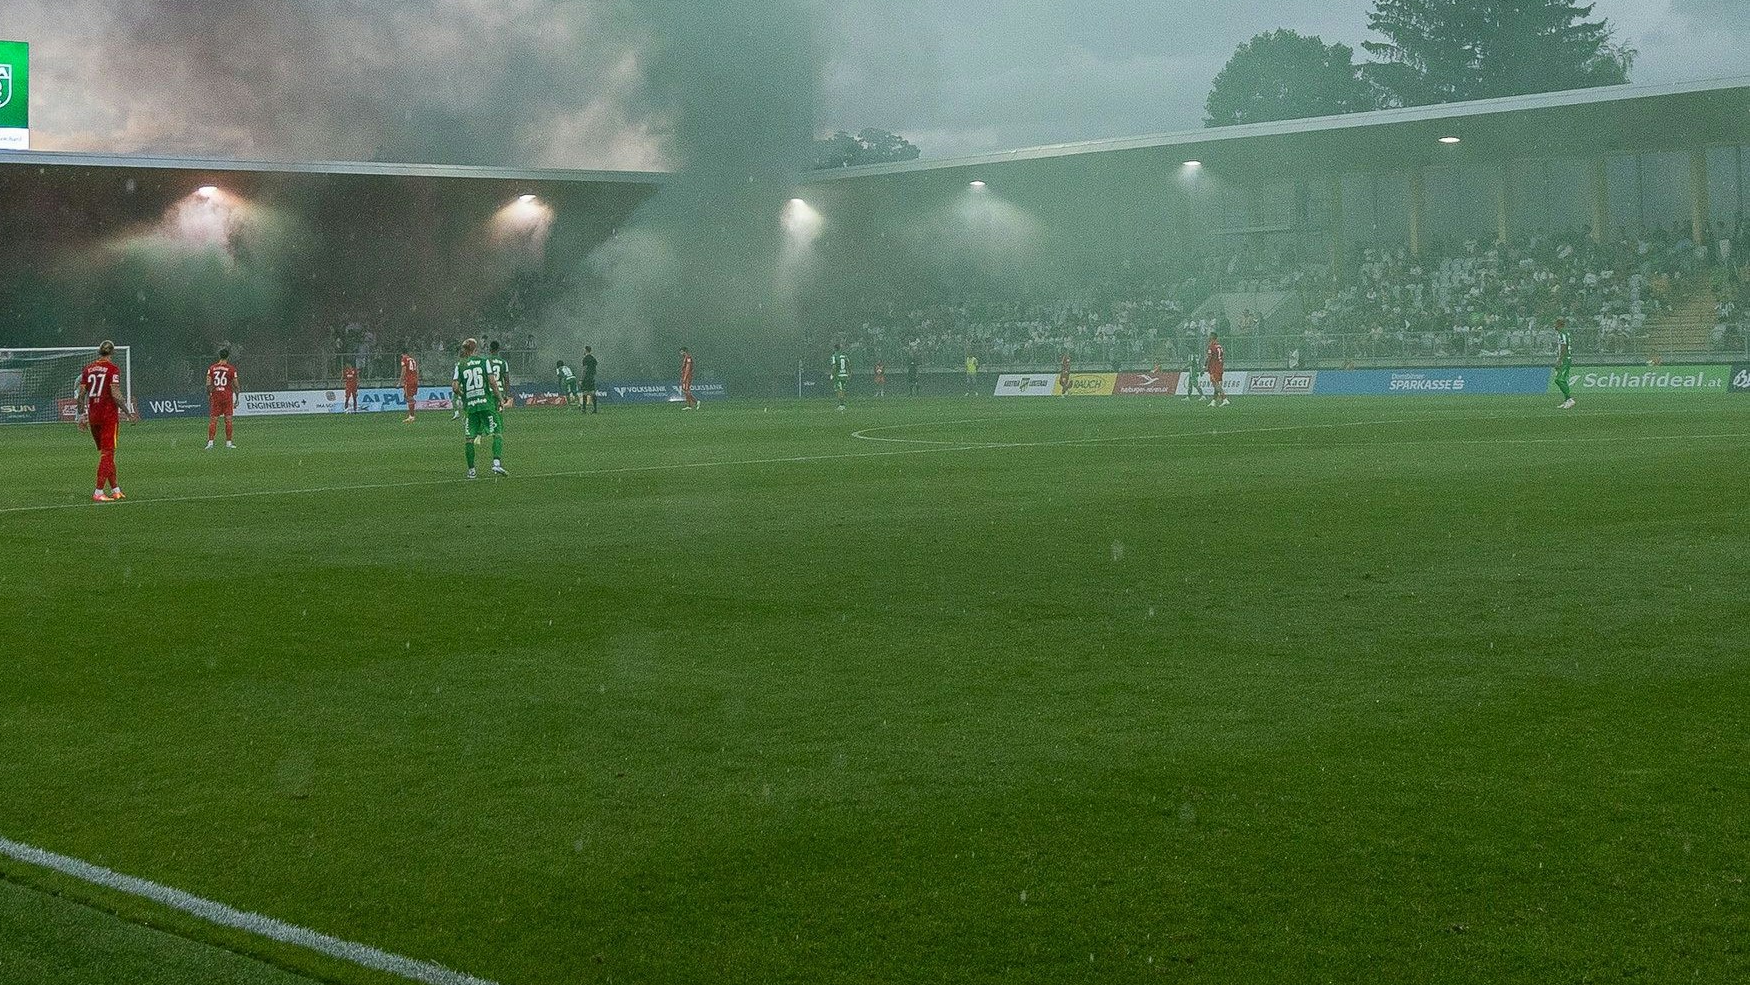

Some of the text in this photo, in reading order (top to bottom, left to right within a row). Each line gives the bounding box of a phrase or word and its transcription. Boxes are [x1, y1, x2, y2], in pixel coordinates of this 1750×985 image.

[213, 371, 227, 386] 36
[463, 367, 483, 391] 26
[87, 374, 106, 397] 27
[1390, 380, 1452, 390] SPARKASSE
[244, 394, 274, 402] UNITED
[1, 405, 36, 413] SUN
[246, 401, 300, 410] ENGINEERING
